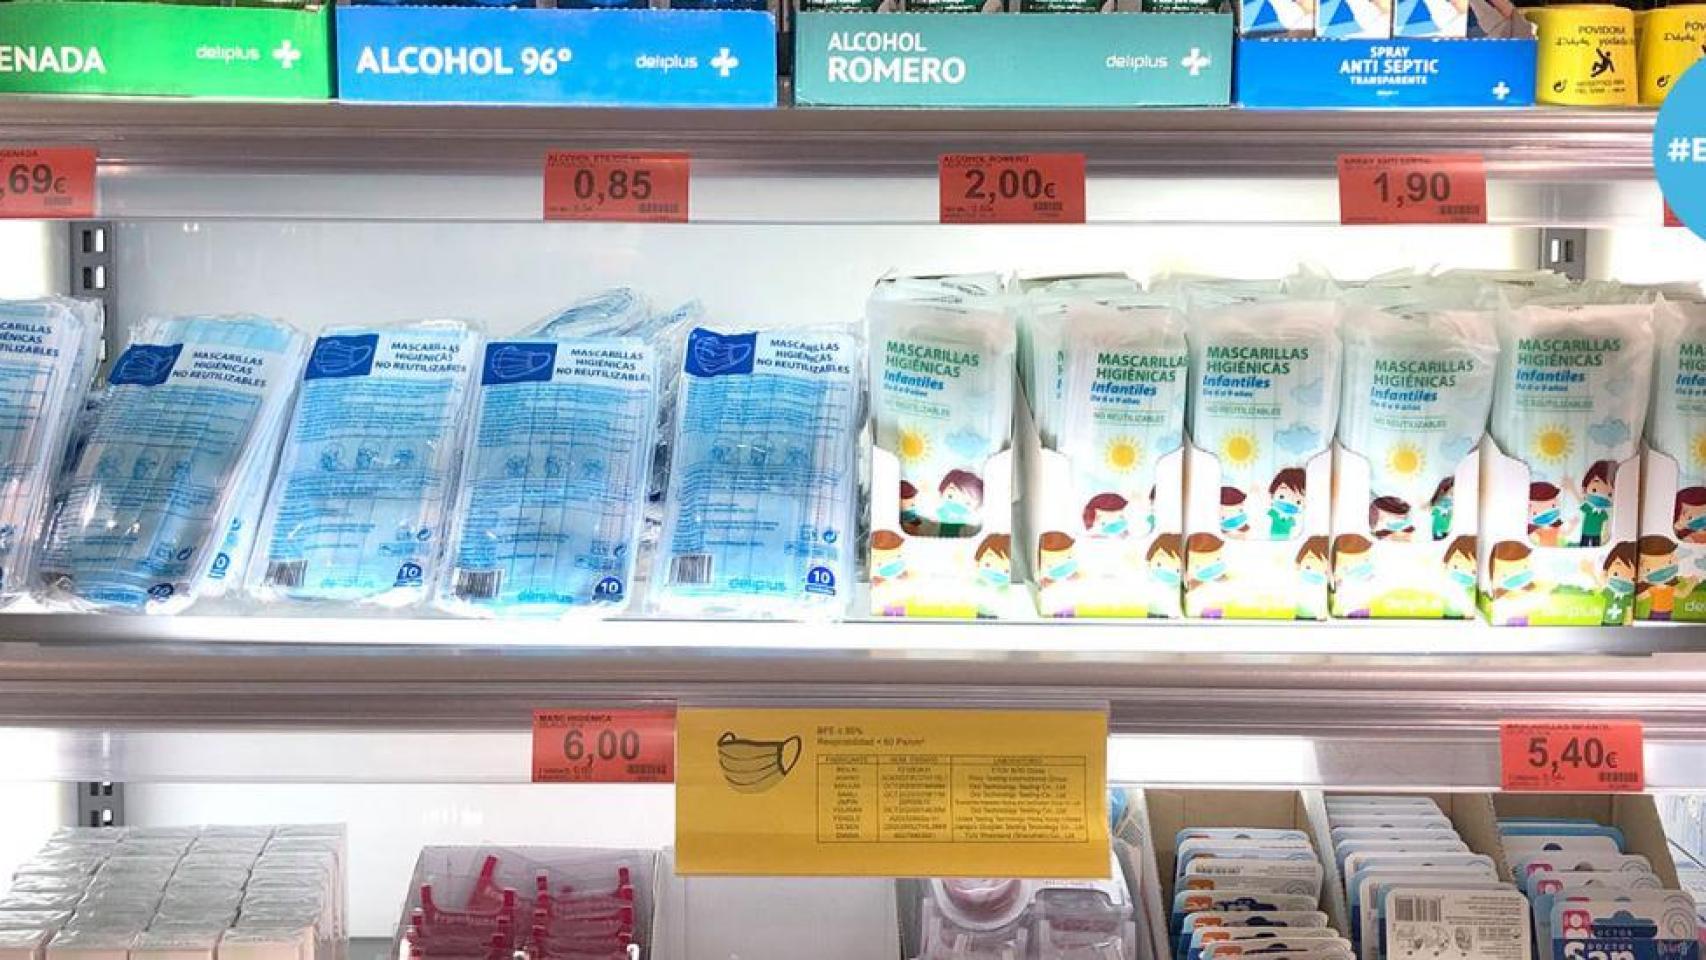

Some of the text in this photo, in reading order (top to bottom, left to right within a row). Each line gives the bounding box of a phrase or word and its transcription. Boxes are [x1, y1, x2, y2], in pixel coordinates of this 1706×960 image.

[828, 33, 926, 51] ALCOHOL
[196, 44, 260, 63] deliplus
[1370, 46, 1410, 58] SPRAY
[356, 46, 513, 75] ALCOHOL
[635, 53, 698, 74] deliplus
[1106, 54, 1168, 72] deliplus
[1340, 59, 1439, 74] ANTI SEPTIC
[827, 57, 966, 83] ROMERO
[1349, 75, 1427, 85] TRANSPARENTE
[574, 168, 651, 206] 0,85
[965, 168, 1056, 204] 2,00€
[1373, 171, 1450, 208] 1,90
[1518, 338, 1621, 352] MASCARILLAS
[193, 351, 263, 365] MASCARILLAS
[571, 348, 643, 360] MASCARILLAS
[887, 341, 979, 367] MASCARILLAS
[1207, 346, 1309, 360] MASCARILLAS
[1517, 353, 1603, 367] HIGIÉNICAS
[756, 358, 773, 367] NO
[1375, 359, 1474, 373] MASCARILLAS
[172, 369, 188, 379] NO
[556, 367, 572, 376] NO
[1516, 367, 1585, 382] Infantiles
[884, 369, 945, 390] Infantiles
[1203, 374, 1271, 388] Infantiles
[1090, 381, 1157, 397] Infantiles
[1371, 386, 1438, 401] Infantiles
[402, 566, 419, 578] 10
[814, 571, 832, 583] 10
[600, 582, 619, 593] 10
[563, 729, 640, 767] 6,00
[1528, 736, 1618, 774] 5,40€
